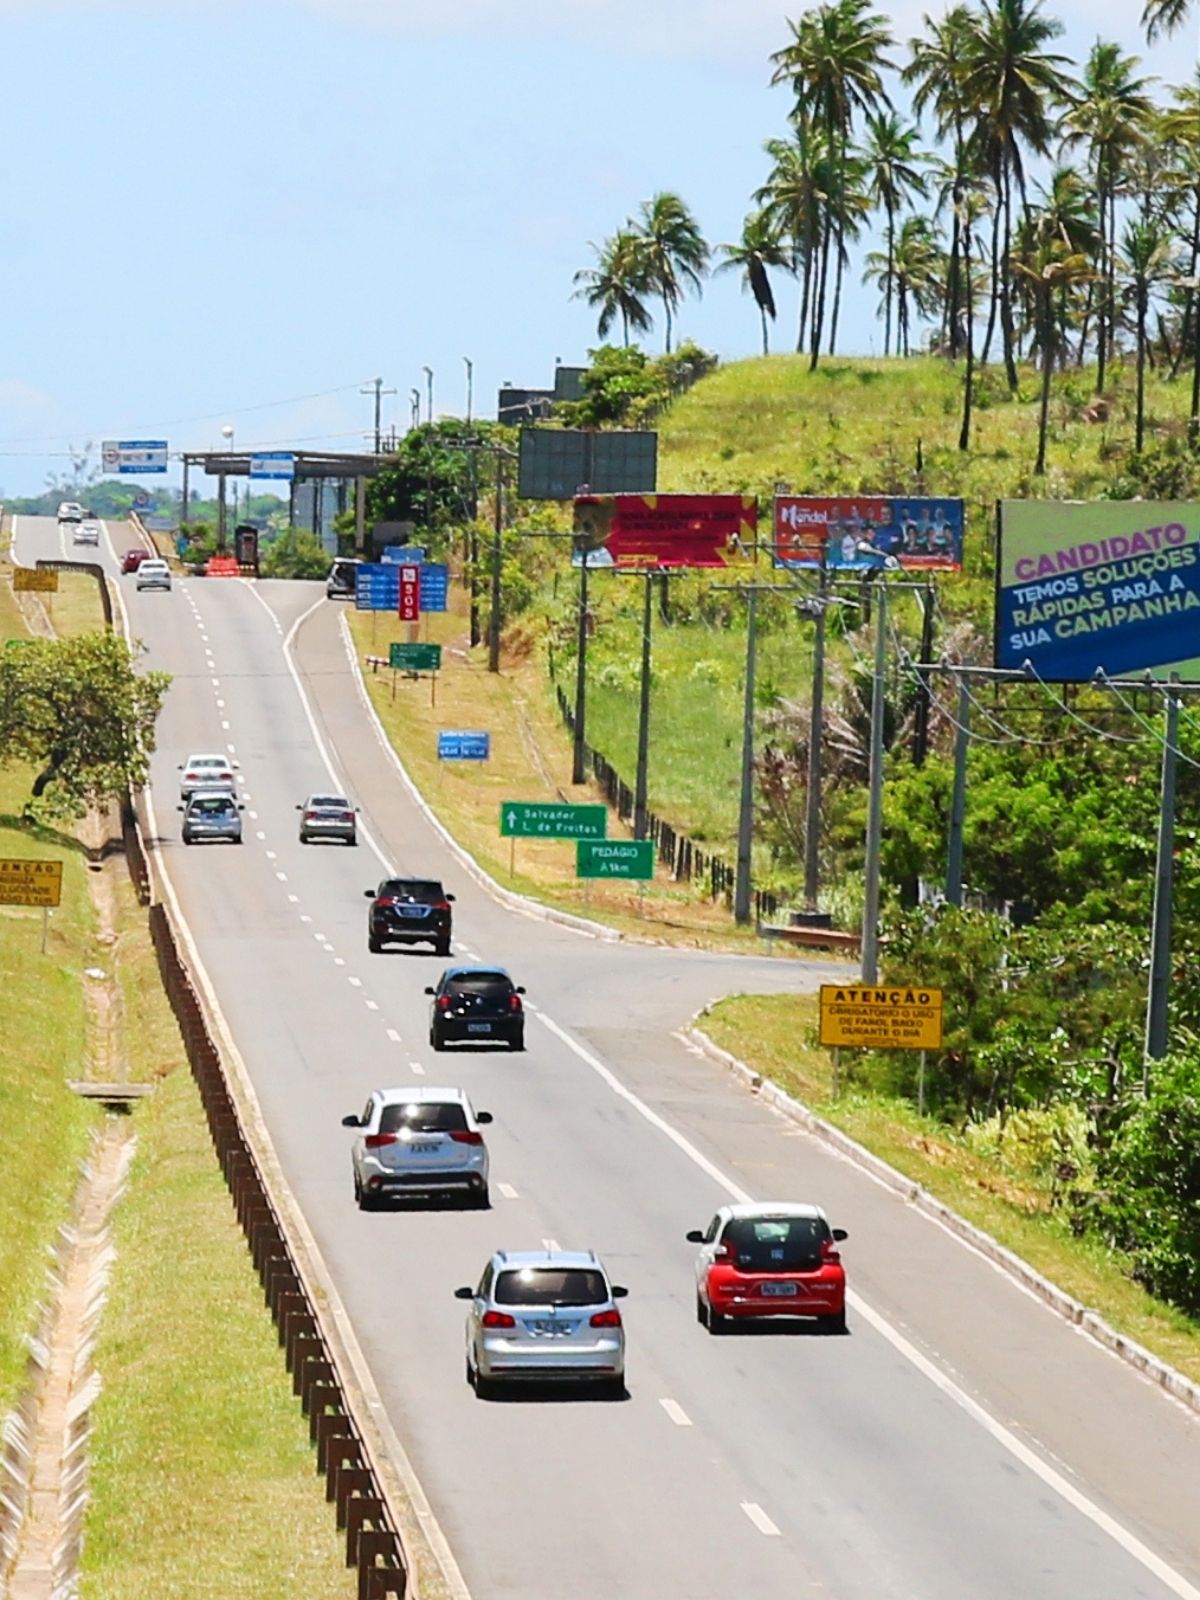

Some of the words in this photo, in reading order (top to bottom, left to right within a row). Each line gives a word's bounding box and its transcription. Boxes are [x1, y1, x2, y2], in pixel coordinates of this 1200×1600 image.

[1012, 577, 1079, 604] TEMOS
[1082, 546, 1197, 588] SOLUÇÕES
[1014, 523, 1187, 581] CANDIDATO
[1009, 628, 1052, 650] SUA
[1054, 590, 1200, 638] CAMPANHA
[1011, 591, 1106, 627] RÁPIDAS
[1111, 579, 1164, 604] PARA
[1169, 574, 1185, 592] A
[523, 808, 576, 820] Salvador
[537, 822, 551, 832] de
[555, 822, 598, 834] Freitas
[834, 988, 931, 1006] ATENÇÃO
